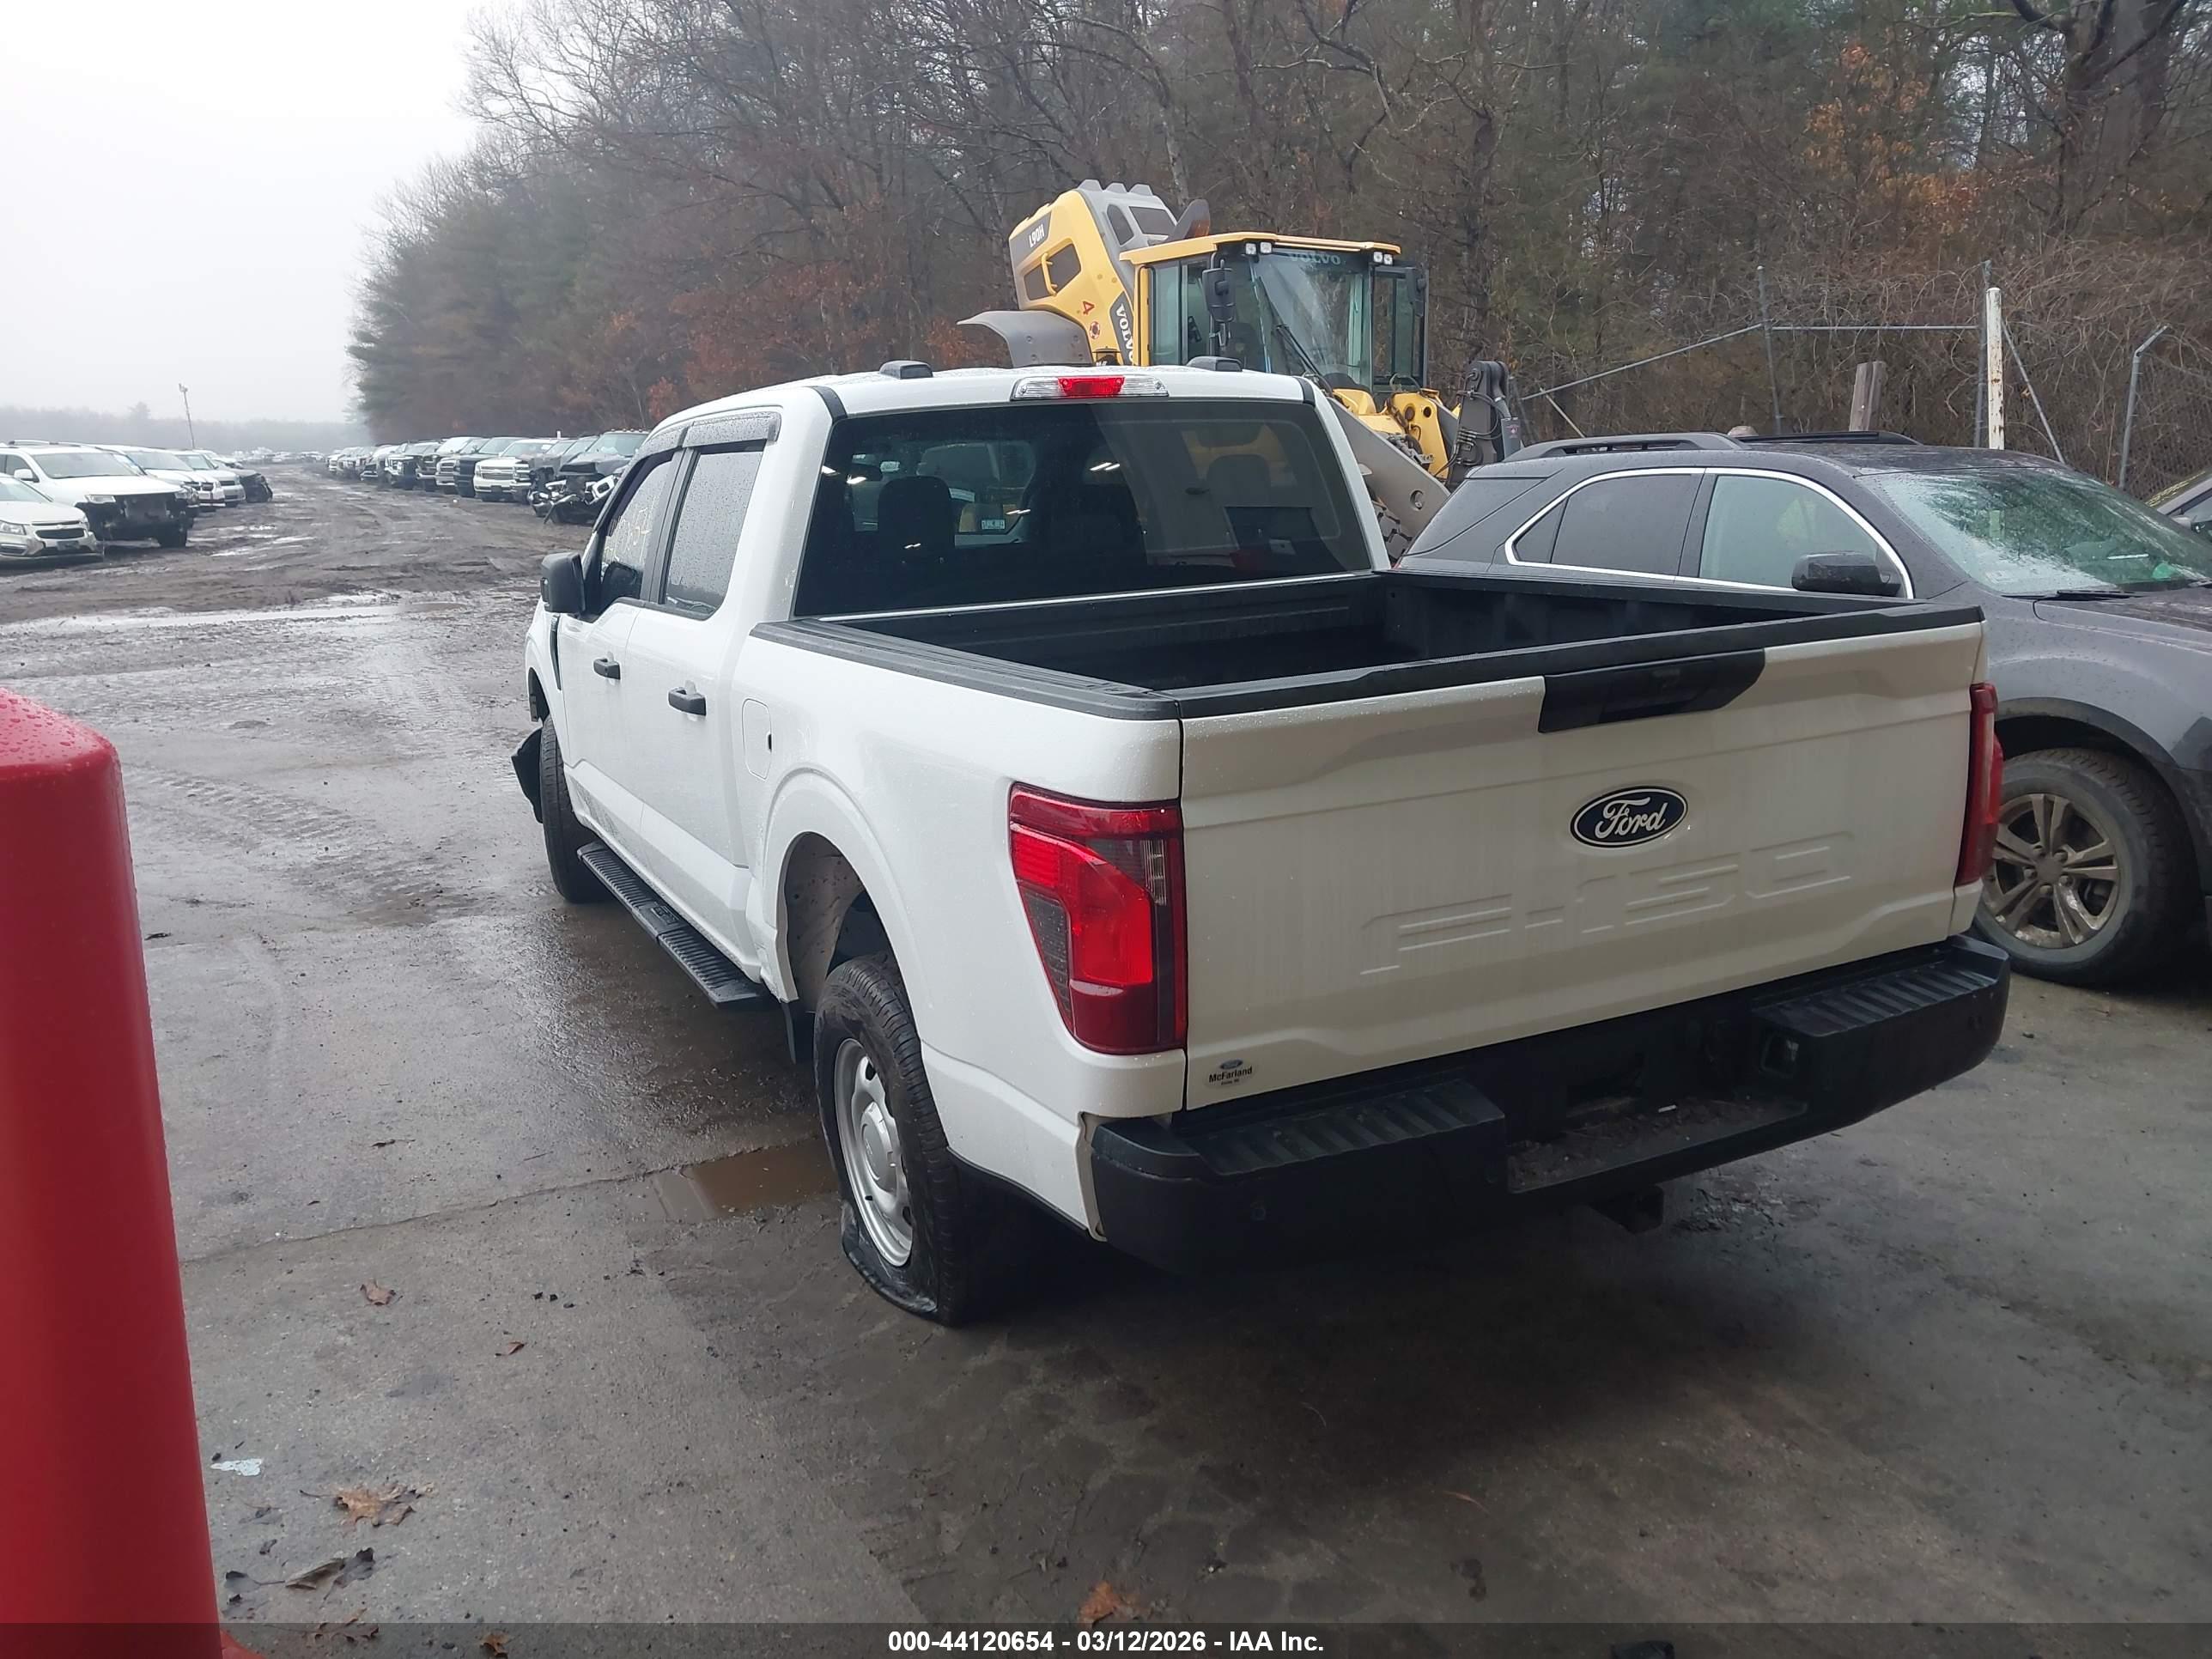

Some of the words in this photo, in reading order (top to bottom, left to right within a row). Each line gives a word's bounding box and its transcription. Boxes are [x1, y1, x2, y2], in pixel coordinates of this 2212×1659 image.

[1028, 223, 1045, 248] L90H
[1595, 797, 1668, 839] Ford
[1361, 830, 1855, 975] F-150
[1208, 1065, 1253, 1083] McFarland
